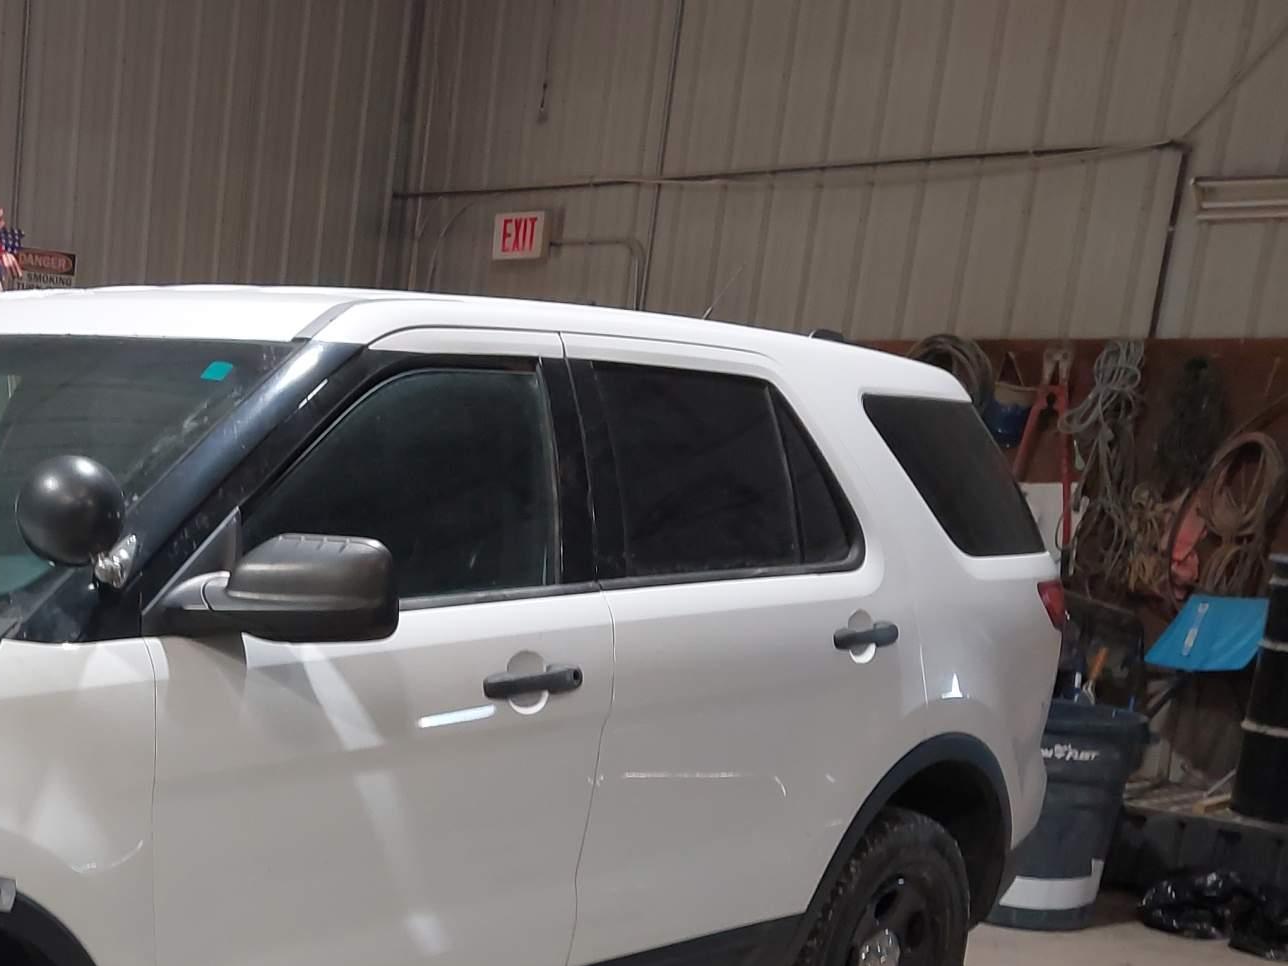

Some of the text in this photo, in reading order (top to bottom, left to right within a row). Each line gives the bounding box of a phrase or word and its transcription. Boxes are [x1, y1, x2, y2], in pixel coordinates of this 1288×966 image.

[502, 217, 538, 252] EXIT
[18, 252, 66, 271] DANGER
[26, 271, 72, 287] SMOKING
